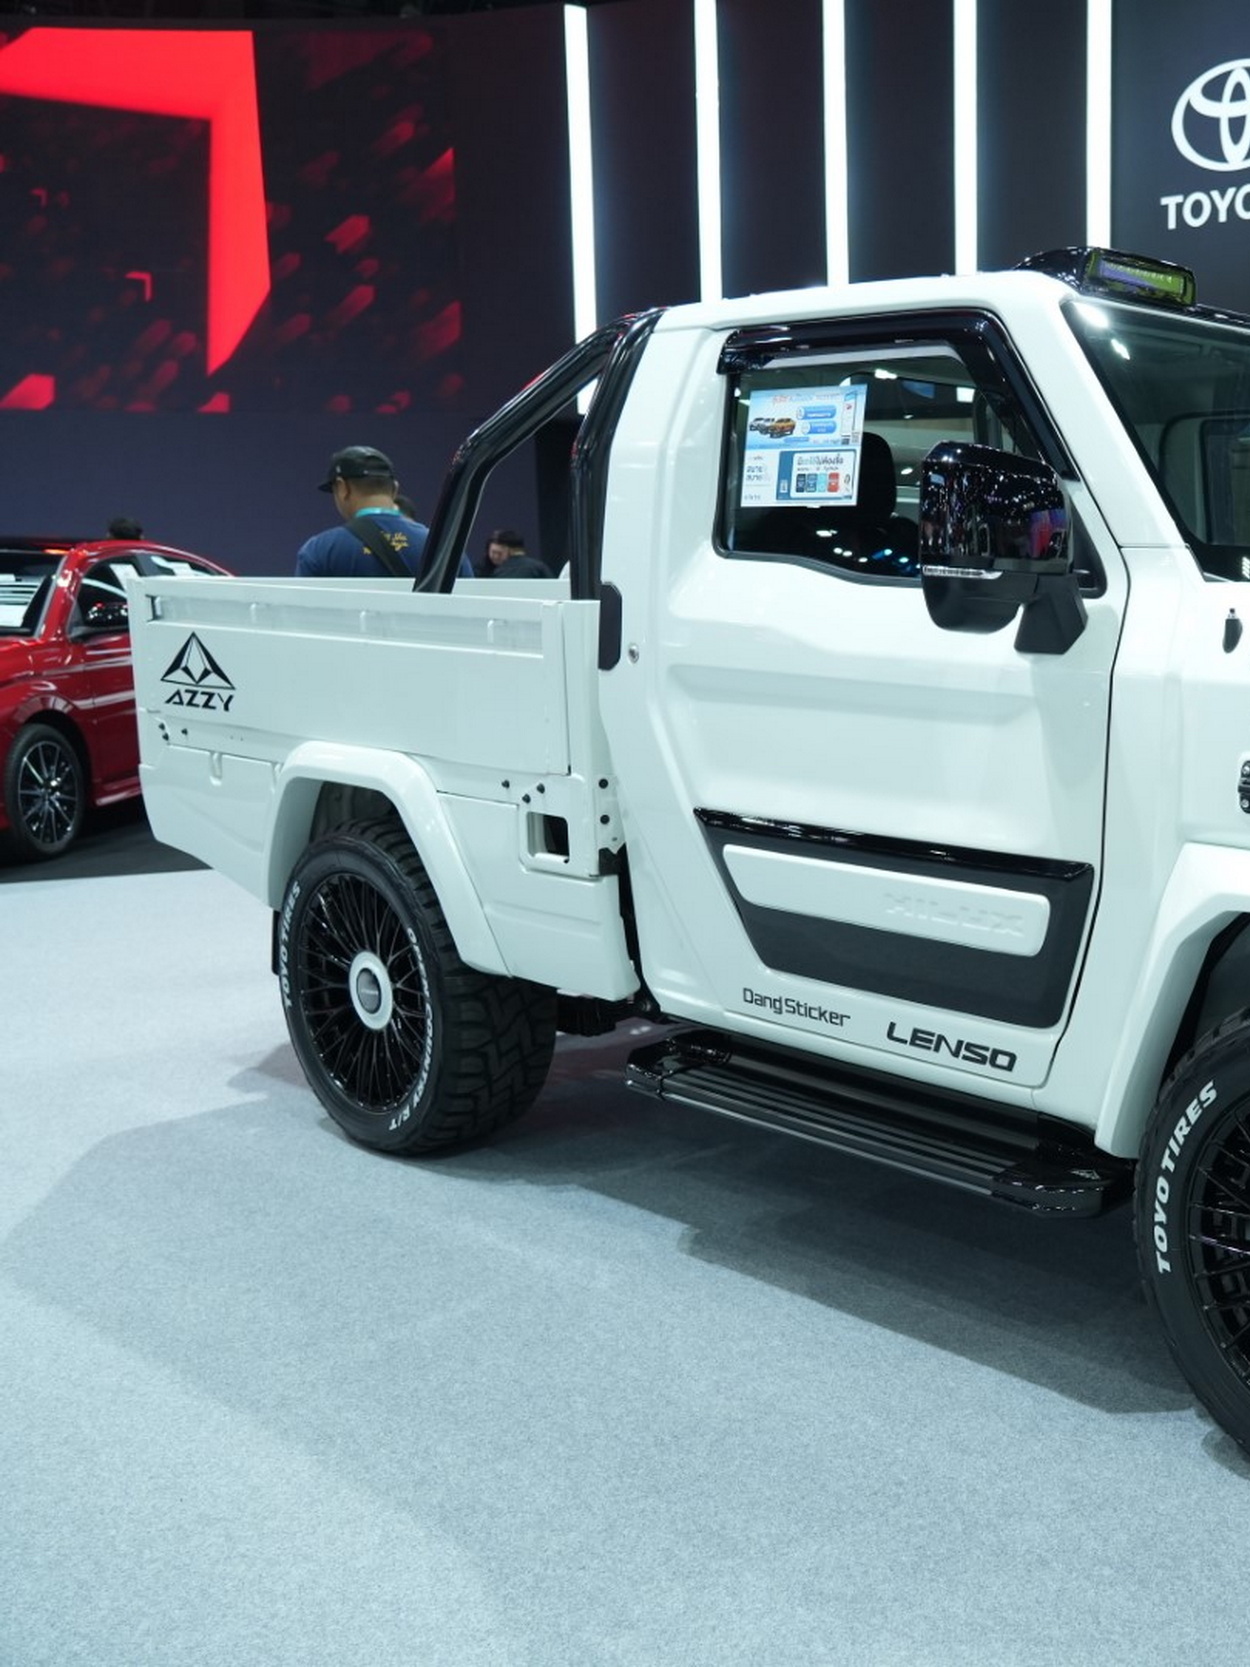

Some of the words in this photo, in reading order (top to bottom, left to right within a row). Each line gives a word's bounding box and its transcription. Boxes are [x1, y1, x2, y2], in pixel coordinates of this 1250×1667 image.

[165, 689, 234, 712] AZZY
[886, 1021, 1018, 1072] LENSO
[1160, 1080, 1218, 1172] TIRES
[1153, 1176, 1172, 1274] TOYO
